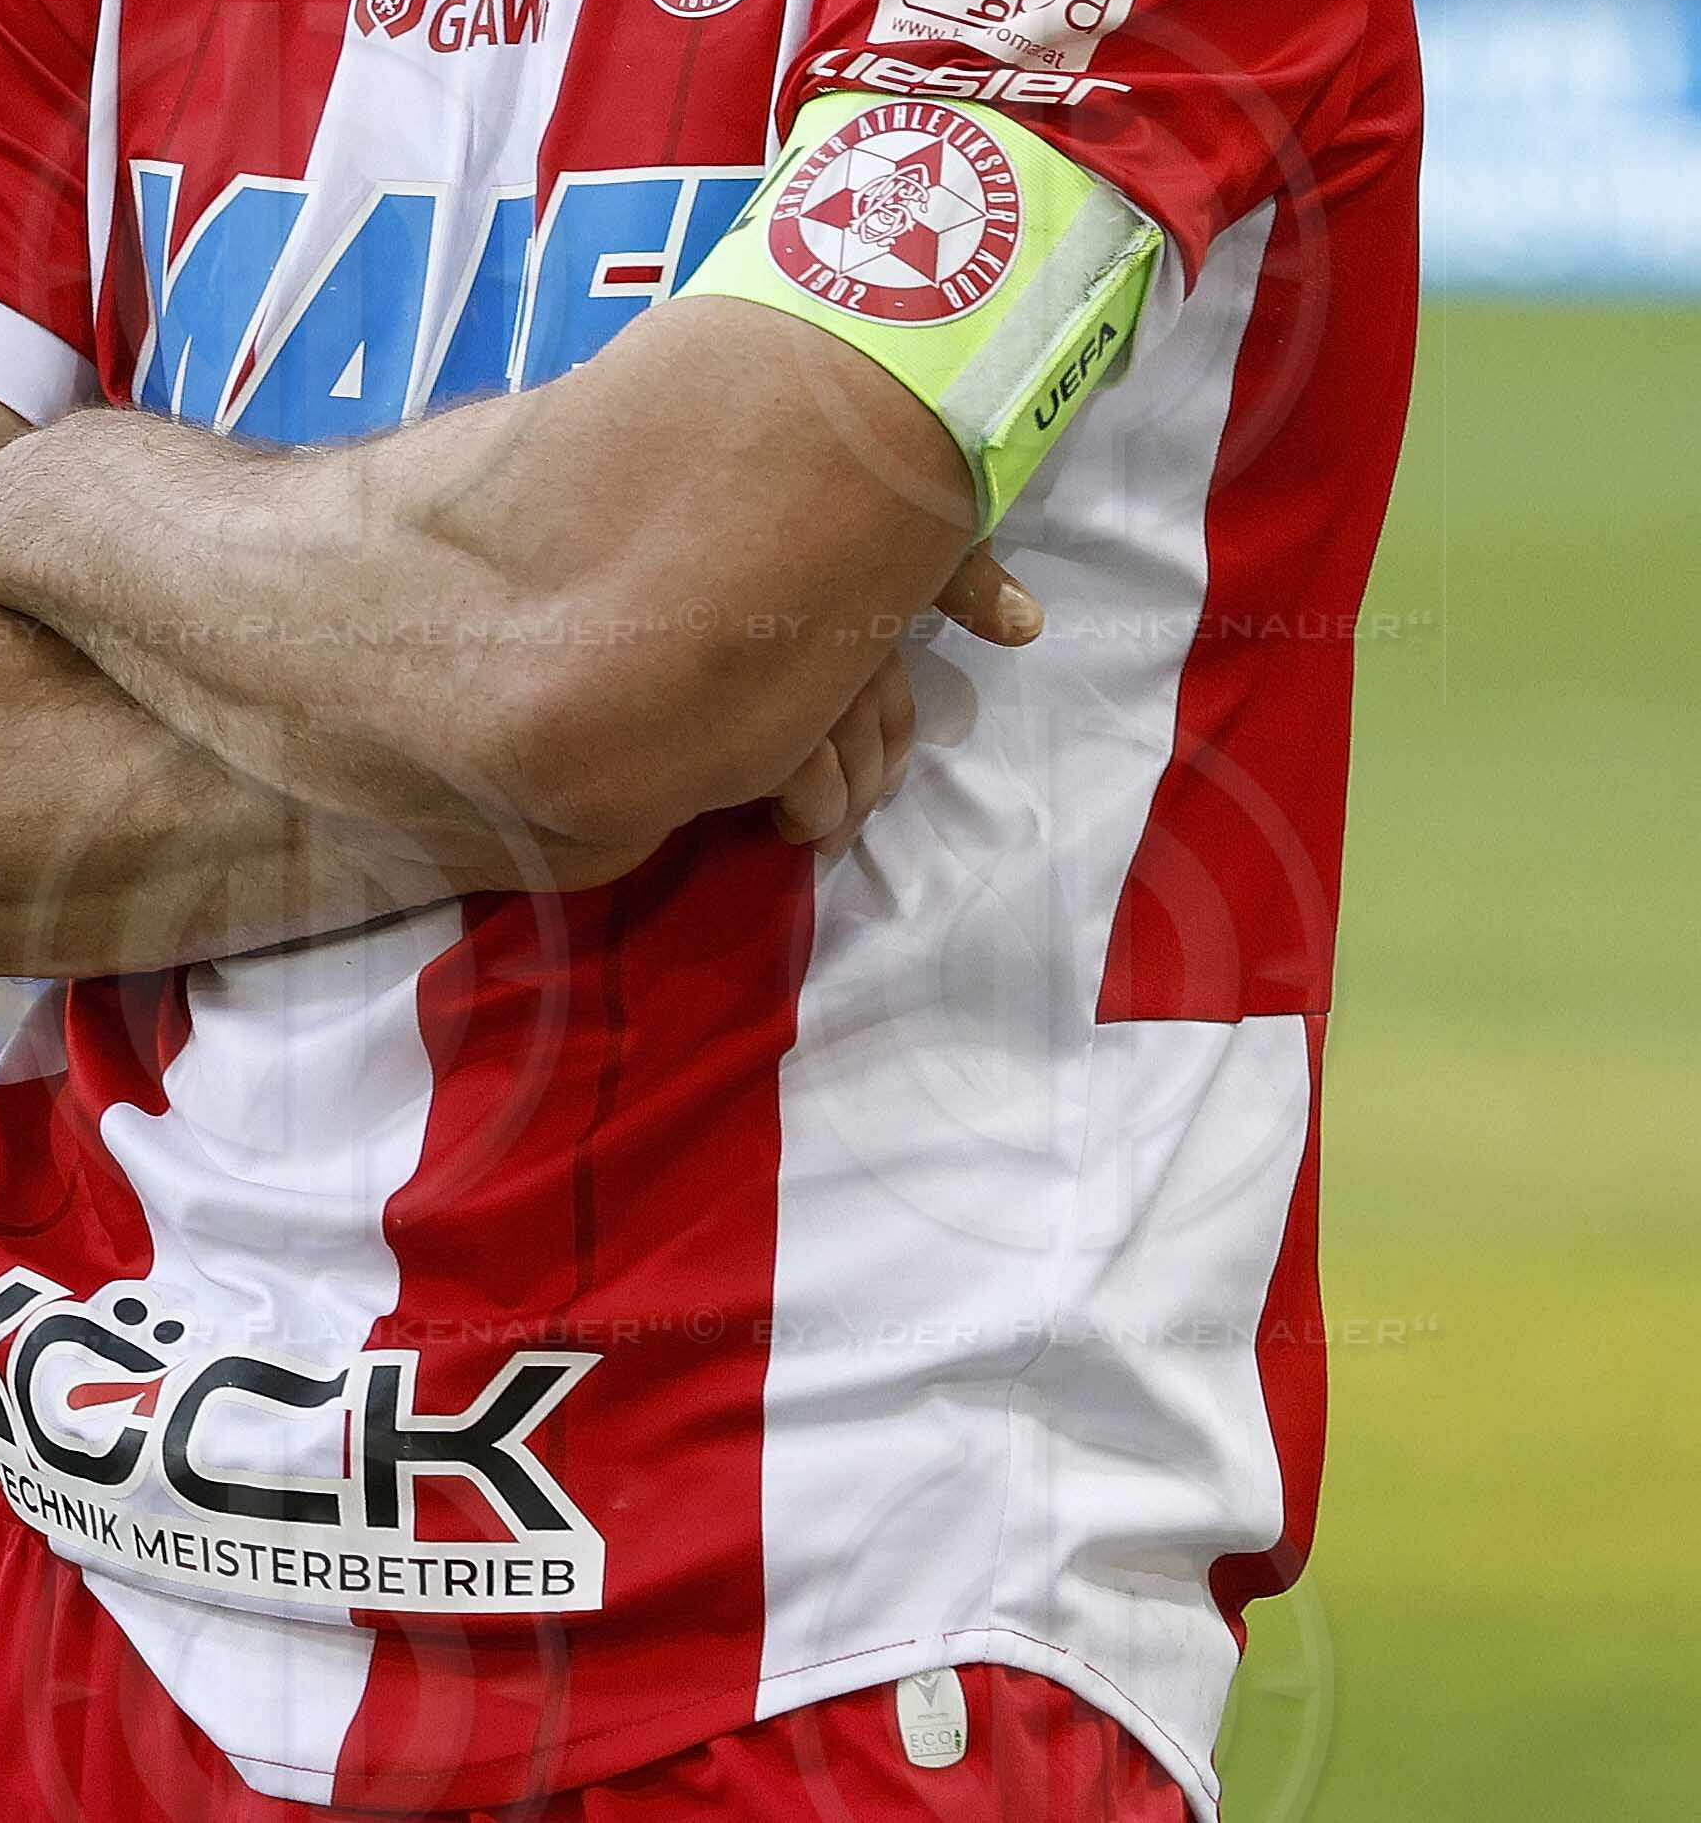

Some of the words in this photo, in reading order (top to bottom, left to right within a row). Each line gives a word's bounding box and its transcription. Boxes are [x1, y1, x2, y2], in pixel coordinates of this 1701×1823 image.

[773, 136, 848, 221] GRAZER
[857, 104, 1017, 243] ATHLETIKSPORT
[941, 248, 1006, 309] KLUB
[798, 262, 868, 310] 1902
[1034, 321, 1117, 431] UEFA
[134, 1527, 576, 1598] MEISTERBETRIEB
